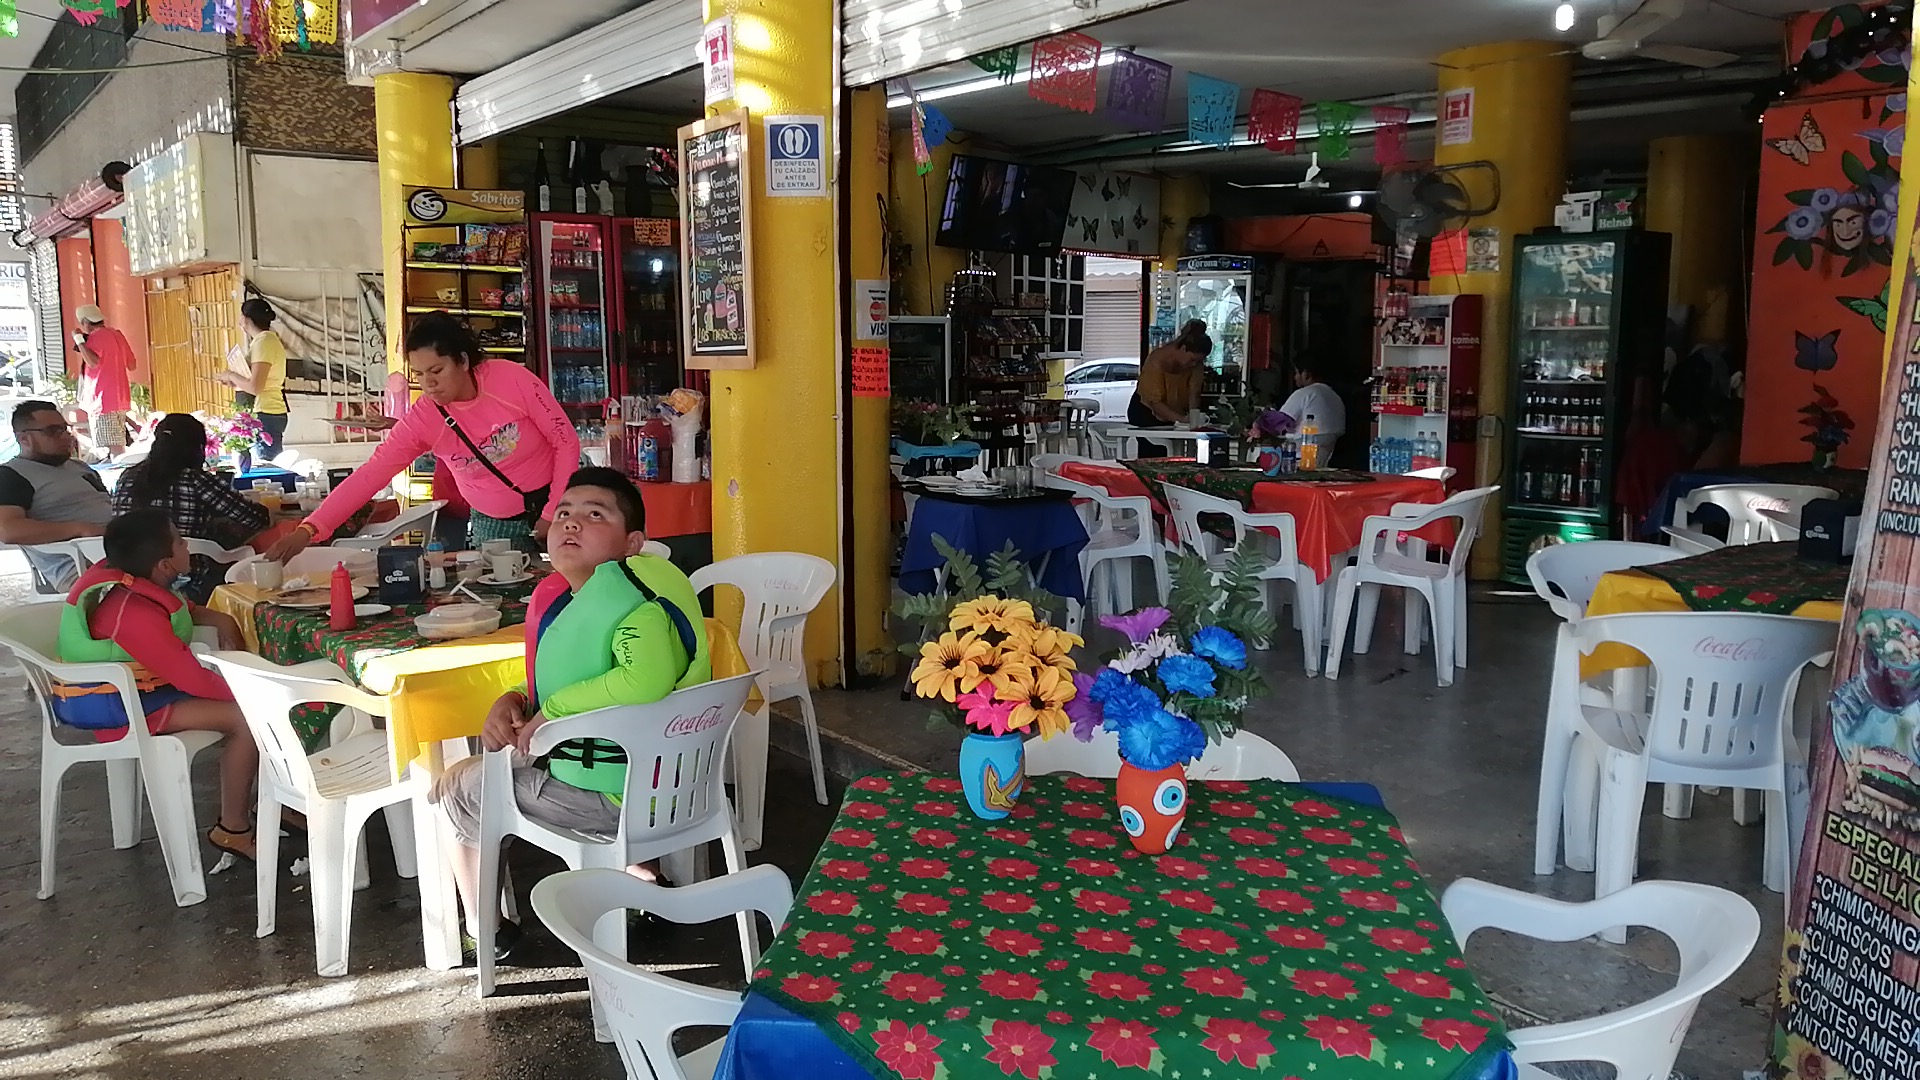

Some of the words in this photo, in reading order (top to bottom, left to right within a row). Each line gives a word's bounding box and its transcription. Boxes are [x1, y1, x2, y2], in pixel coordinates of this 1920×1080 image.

[471, 190, 521, 206] Sabritas
[1187, 257, 1219, 270] Corona
[664, 702, 725, 739] Coca-Cola
[1850, 855, 1879, 891] DE
[1882, 872, 1908, 909] LA
